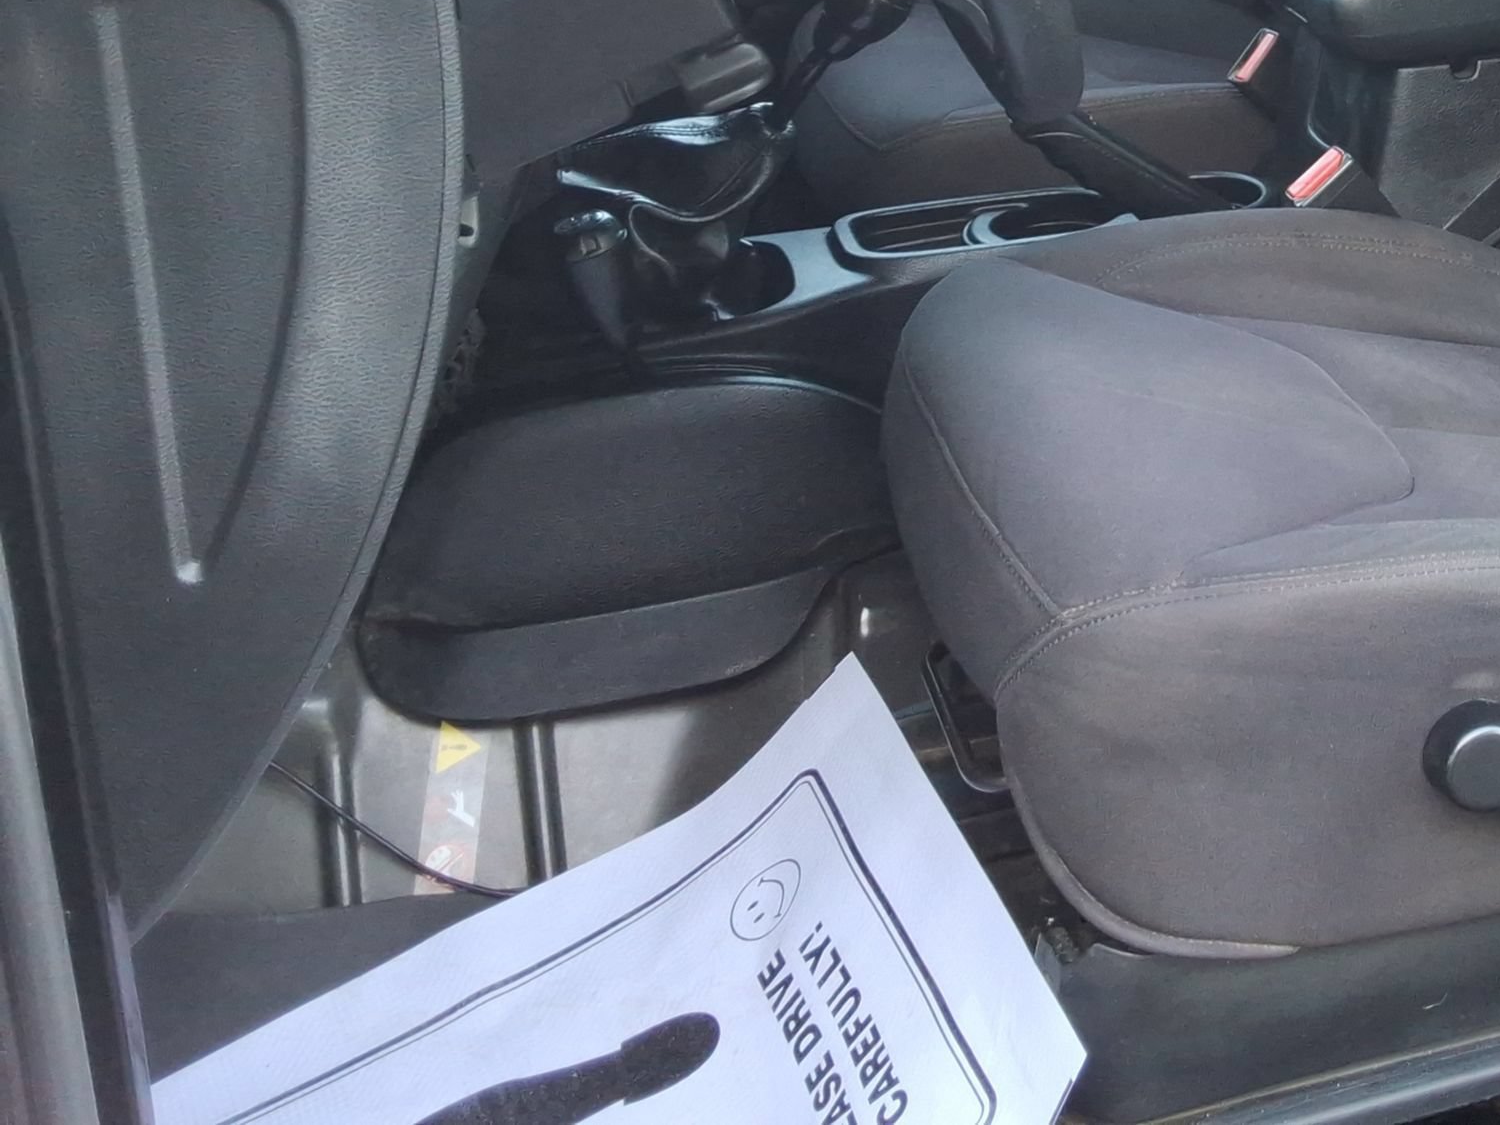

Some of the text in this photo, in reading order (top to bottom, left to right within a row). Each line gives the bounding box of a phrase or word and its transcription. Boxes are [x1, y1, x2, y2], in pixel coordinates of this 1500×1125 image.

[757, 948, 857, 1125] ASE DRIVE
[799, 920, 908, 1125] CAREFULLY!
